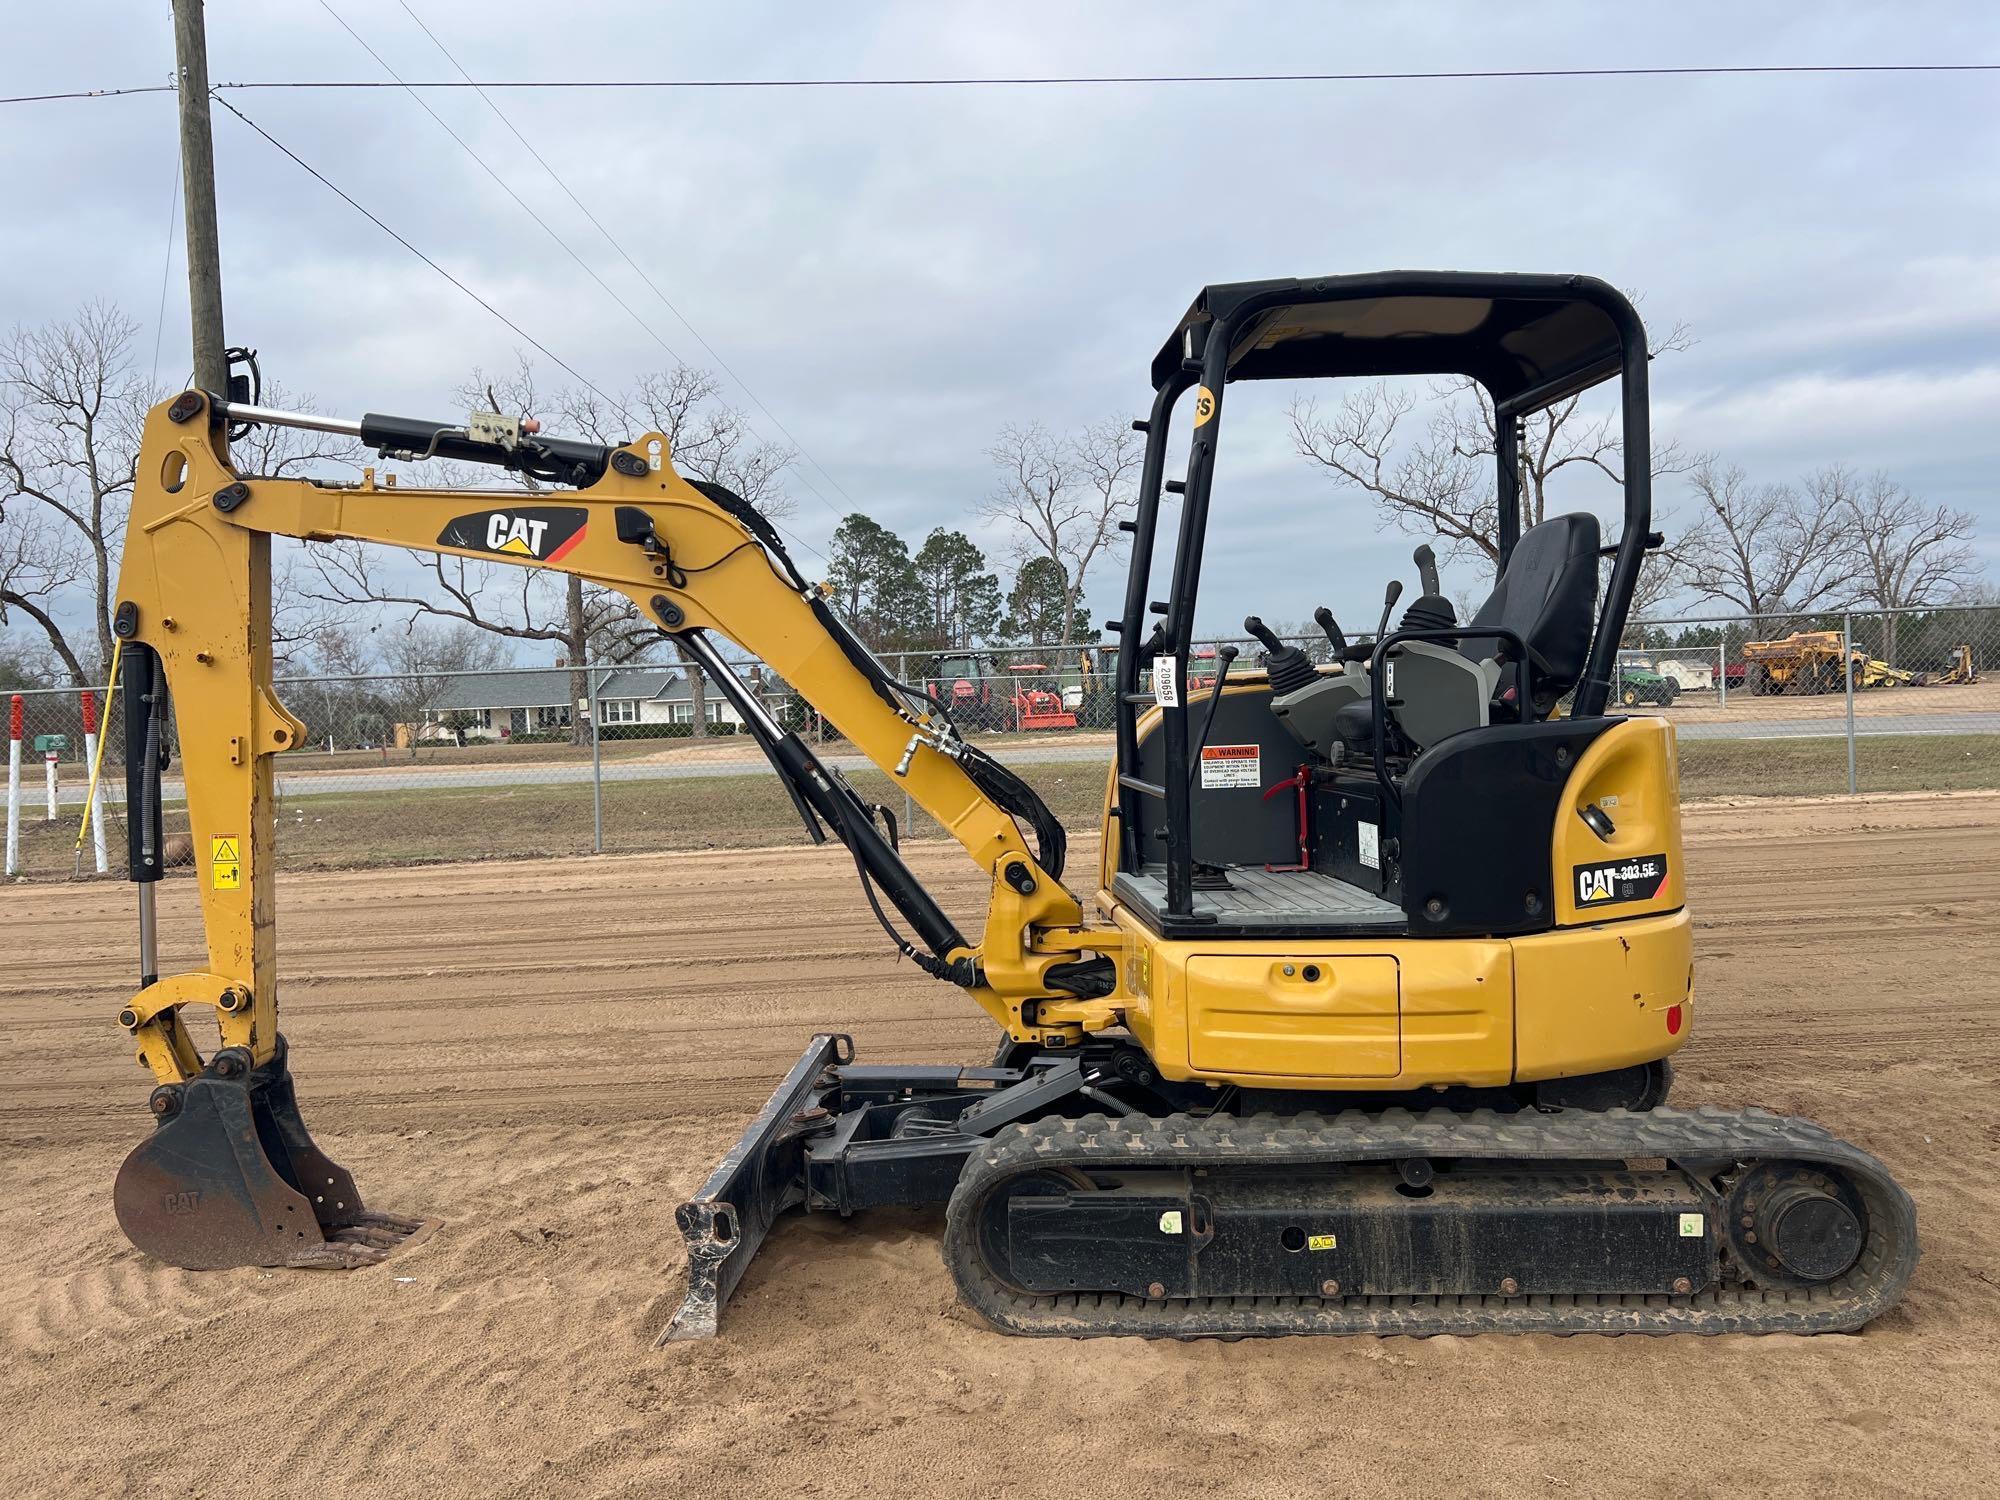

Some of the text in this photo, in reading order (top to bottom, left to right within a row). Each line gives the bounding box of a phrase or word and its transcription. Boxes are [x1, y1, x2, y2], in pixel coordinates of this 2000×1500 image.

[486, 513, 549, 557] CAT
[1160, 668, 1174, 701] 209658
[1218, 748, 1255, 756] WARNING
[1580, 868, 1616, 901] CAT
